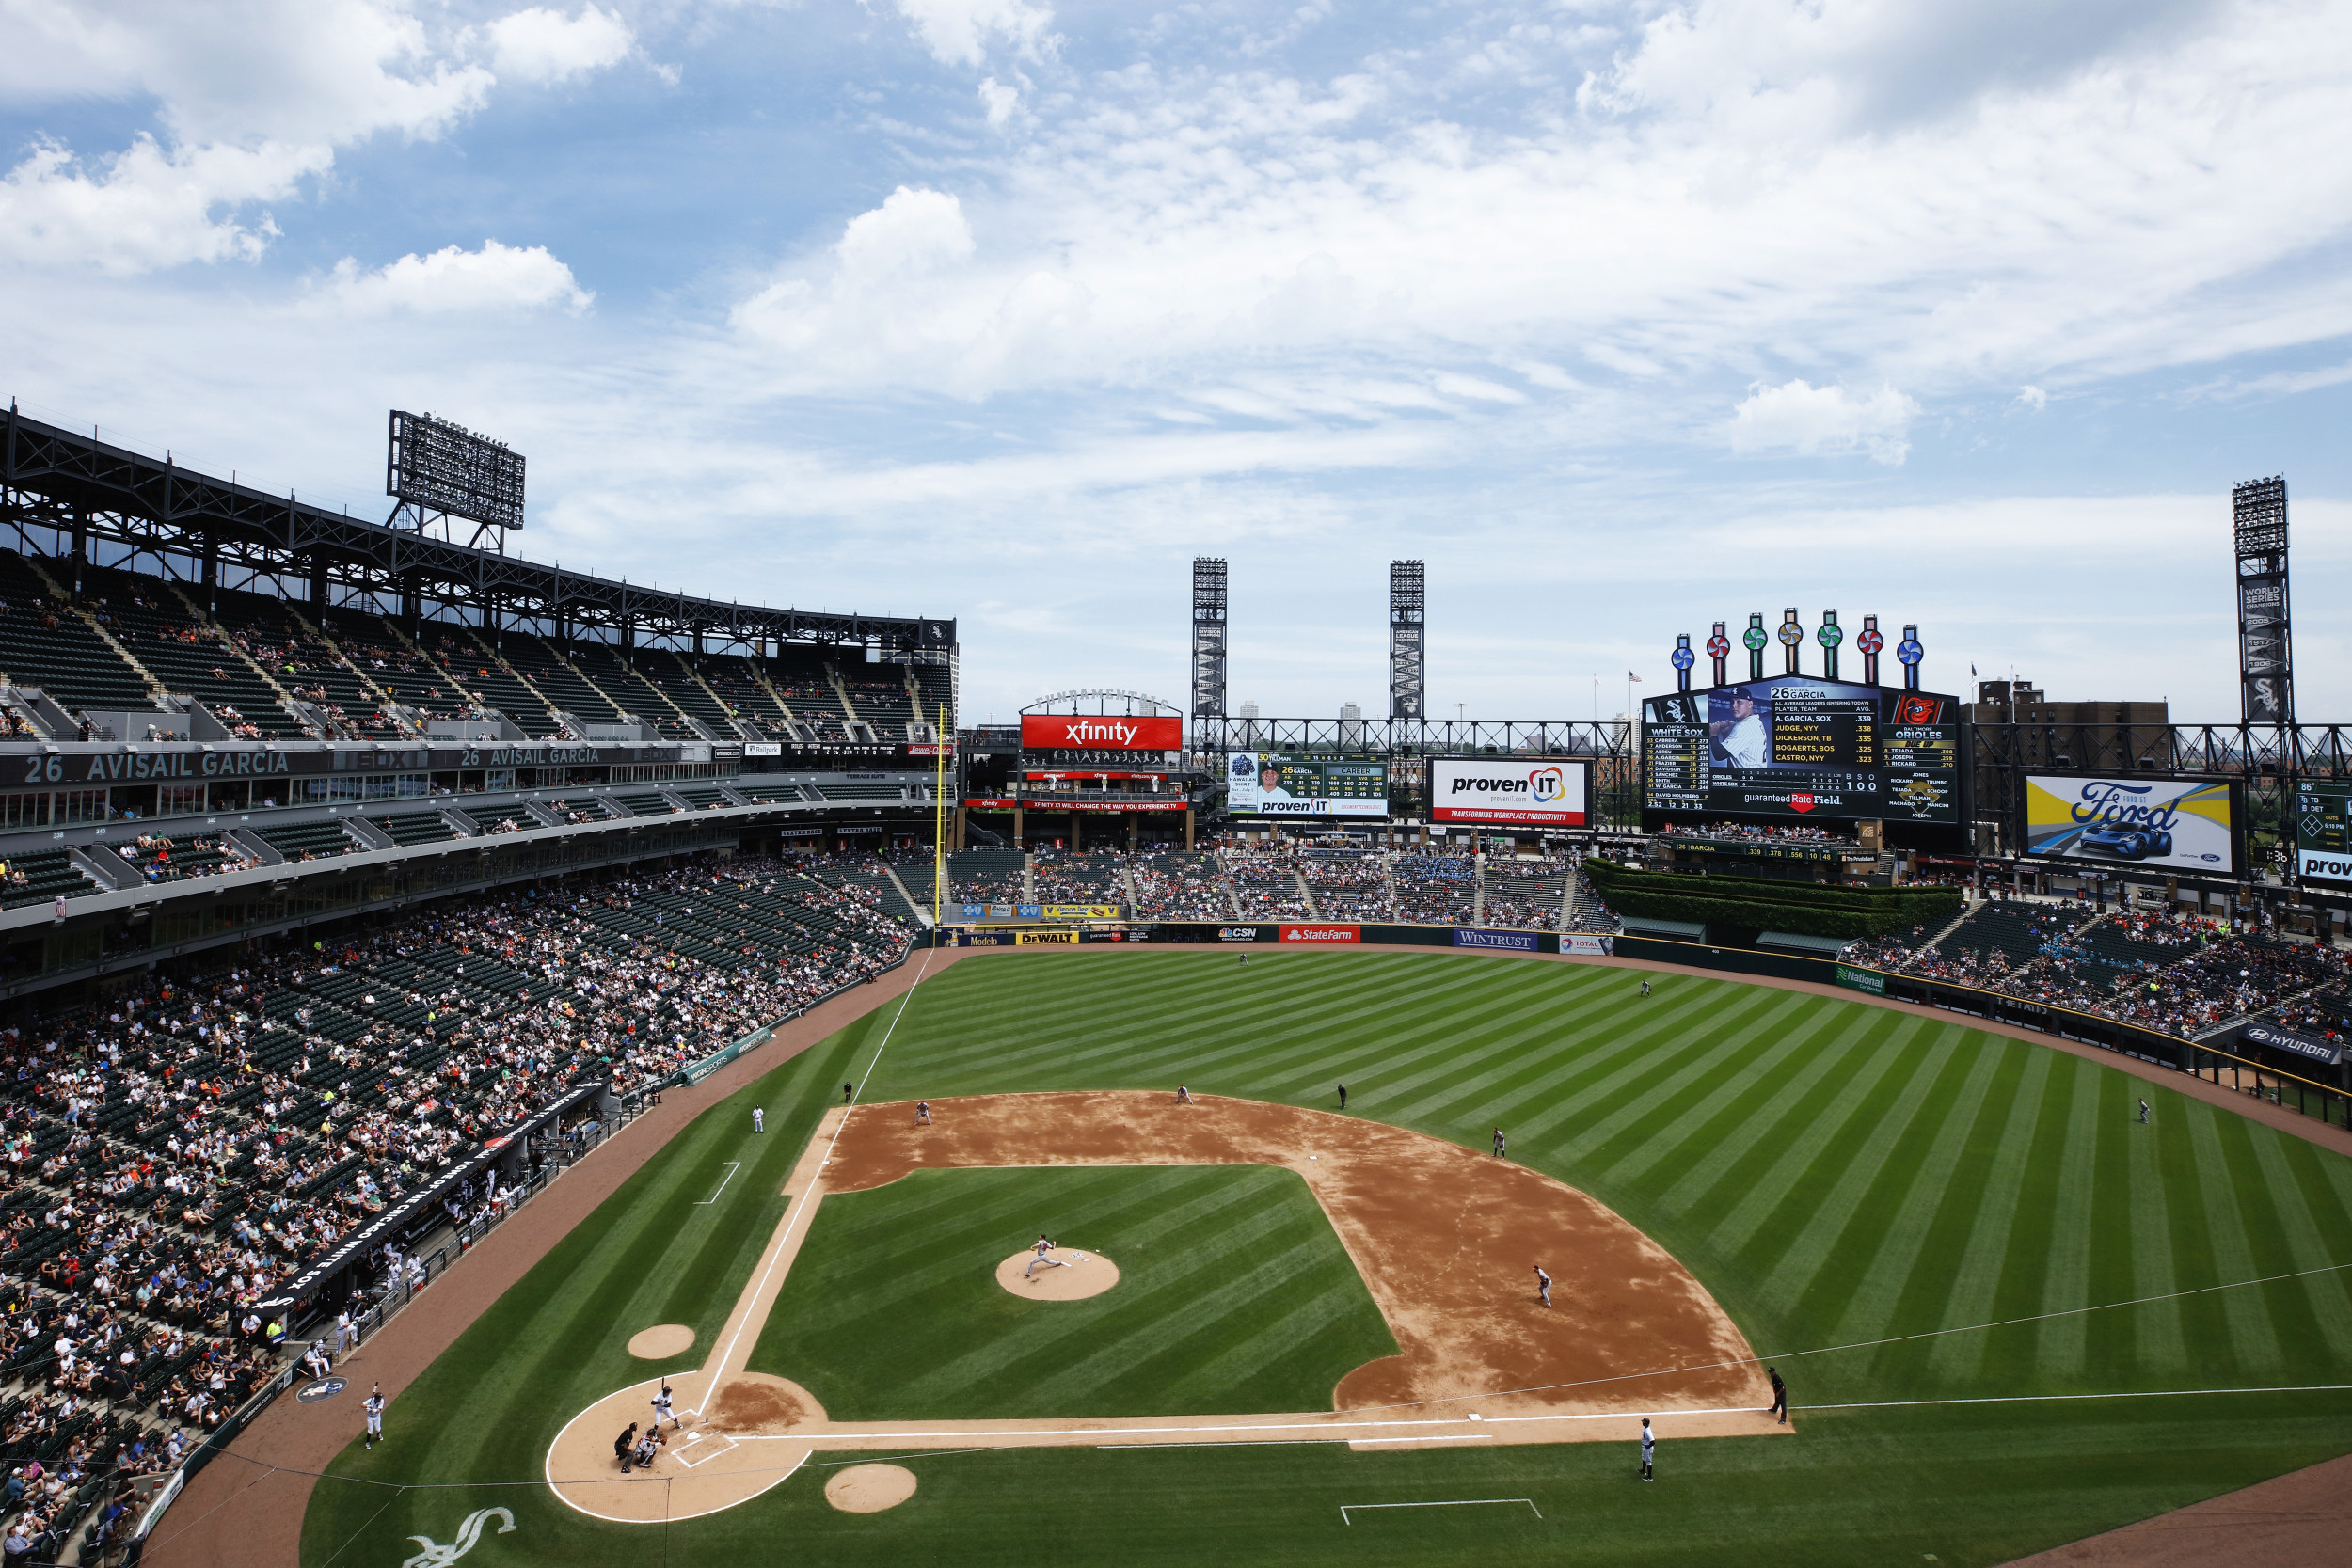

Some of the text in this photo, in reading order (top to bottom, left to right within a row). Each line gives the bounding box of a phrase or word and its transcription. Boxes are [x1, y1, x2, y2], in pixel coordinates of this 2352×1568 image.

[2245, 586, 2280, 596] WORLD
[2246, 594, 2280, 603] SERIES
[1035, 688, 1168, 710] FUNDAMENTALS
[1772, 687, 1789, 698] 26
[1065, 721, 1138, 745] xfinity
[1895, 731, 1943, 740] ORIOLES
[461, 749, 599, 766] 26 AVISAIL GARCIA
[24, 752, 289, 782] 26 AVISAIL GARCIA
[1451, 777, 1556, 794] proven IT
[1744, 794, 1790, 803] guaranteed
[1791, 794, 1812, 803] Rate
[2071, 782, 2182, 831] Ford
[1262, 801, 1327, 813] proven IT
[1451, 810, 1567, 821] TRANSFORMING WORKPLACE PRODUCTIVITY
[2266, 851, 2288, 862] 1:36
[1232, 928, 1257, 937] CSN
[1459, 931, 1532, 947] WINTRUST
[970, 936, 998, 946] Modelo
[1847, 971, 1884, 988] National
[2269, 1034, 2332, 1059] HYUNDAI
[546, 1089, 585, 1111] WELCOME
[440, 1161, 474, 1179] HOME
[428, 1180, 446, 1189] OF
[405, 1190, 433, 1204] THE
[358, 1204, 410, 1238] CHICAGO
[315, 1240, 363, 1268] WHITE
[286, 1270, 322, 1290] SOX
